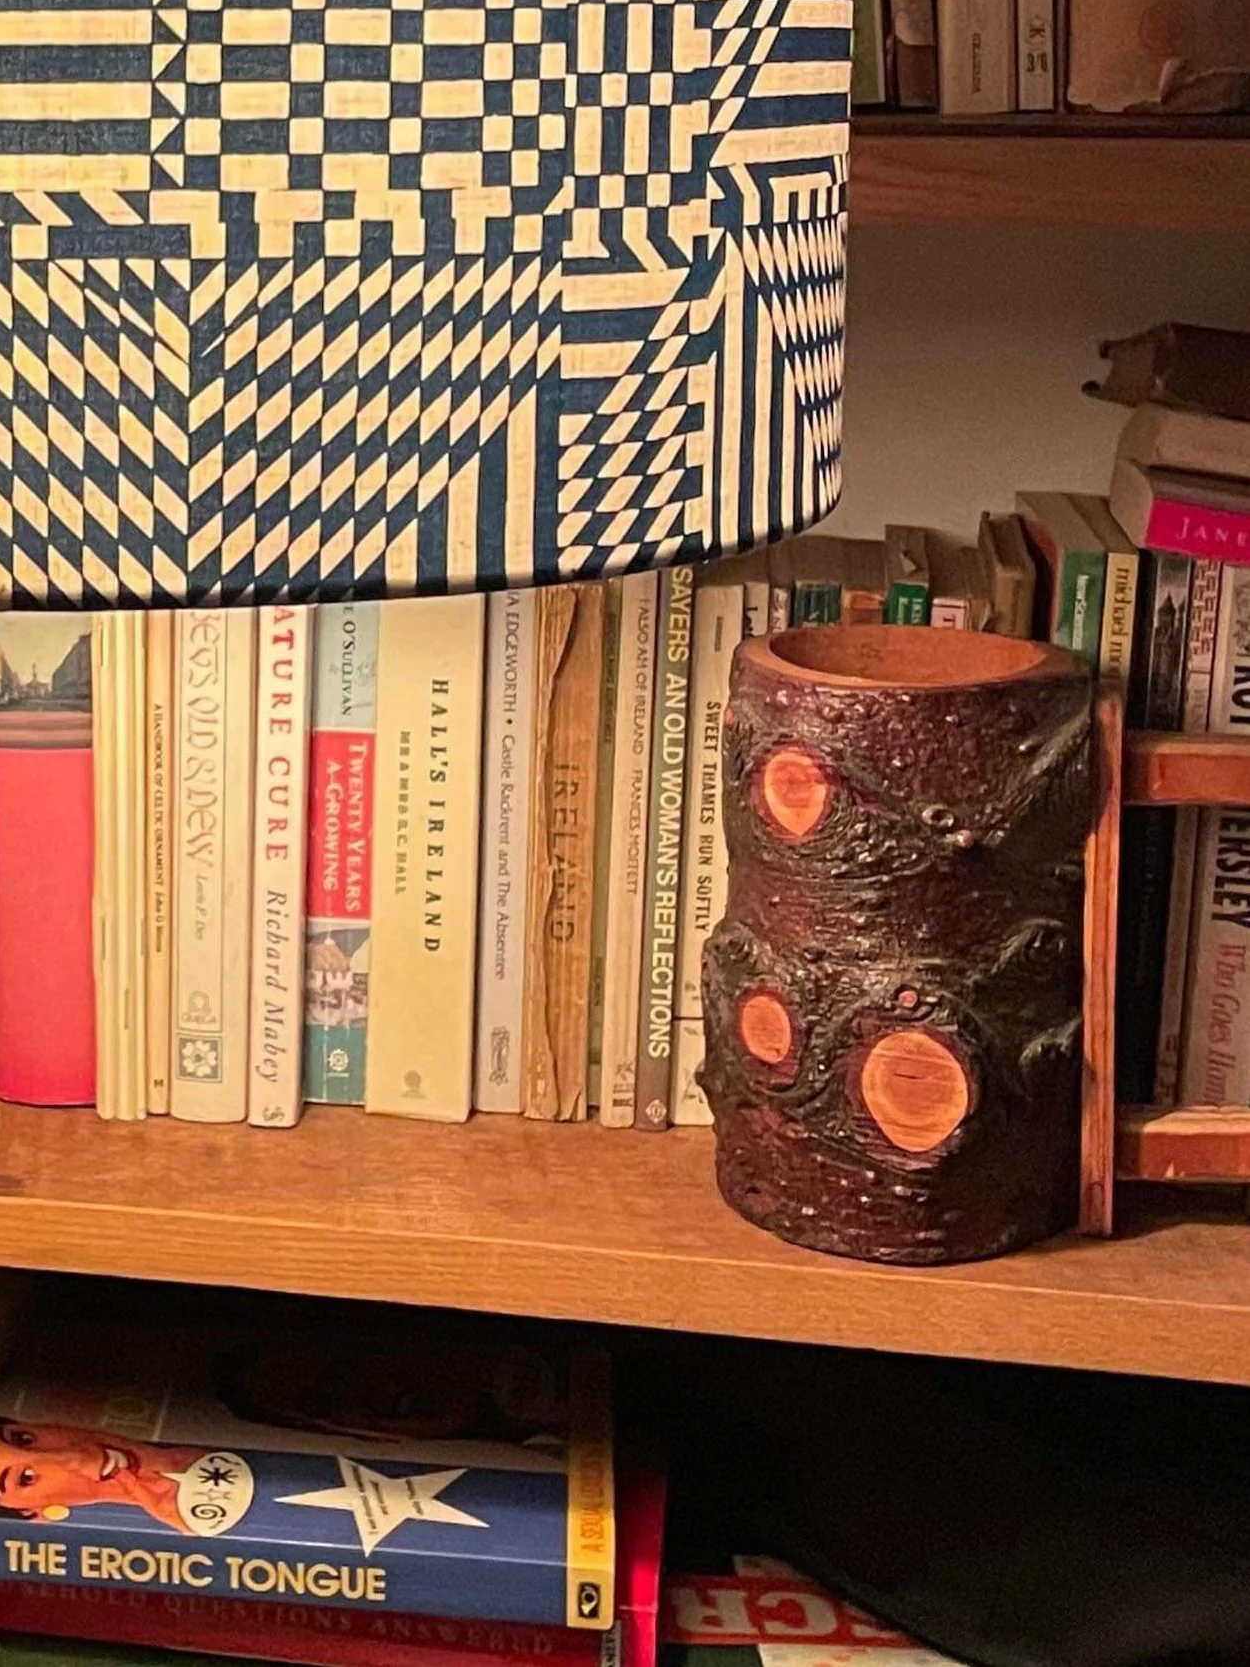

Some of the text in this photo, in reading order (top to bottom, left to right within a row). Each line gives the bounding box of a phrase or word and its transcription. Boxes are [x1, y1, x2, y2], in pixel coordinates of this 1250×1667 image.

[339, 621, 357, 715] O'SULLIVAN
[502, 611, 519, 712] EDGEWORTH
[153, 714, 163, 770] HANDBOOK
[186, 697, 220, 749] OLD
[632, 673, 647, 755] OF IRELAND
[154, 774, 163, 787] OF
[265, 757, 290, 862] CURE
[344, 740, 368, 912] TWENTY YEARS
[423, 679, 449, 953] HALL'S IRELAND
[630, 770, 643, 831] FRANCES
[648, 568, 692, 1057] SAYERS AN OLD WOMAN'S REFLECTIONS
[694, 701, 721, 932] SWEET THAMES RUN SOFTLY
[154, 829, 164, 886] ORNAMENT
[494, 735, 517, 980] Castle Rackrent and The Absentee
[258, 891, 287, 1084] Richard Mabey
[6, 1540, 387, 1603] THE EROTIC TONGUE
